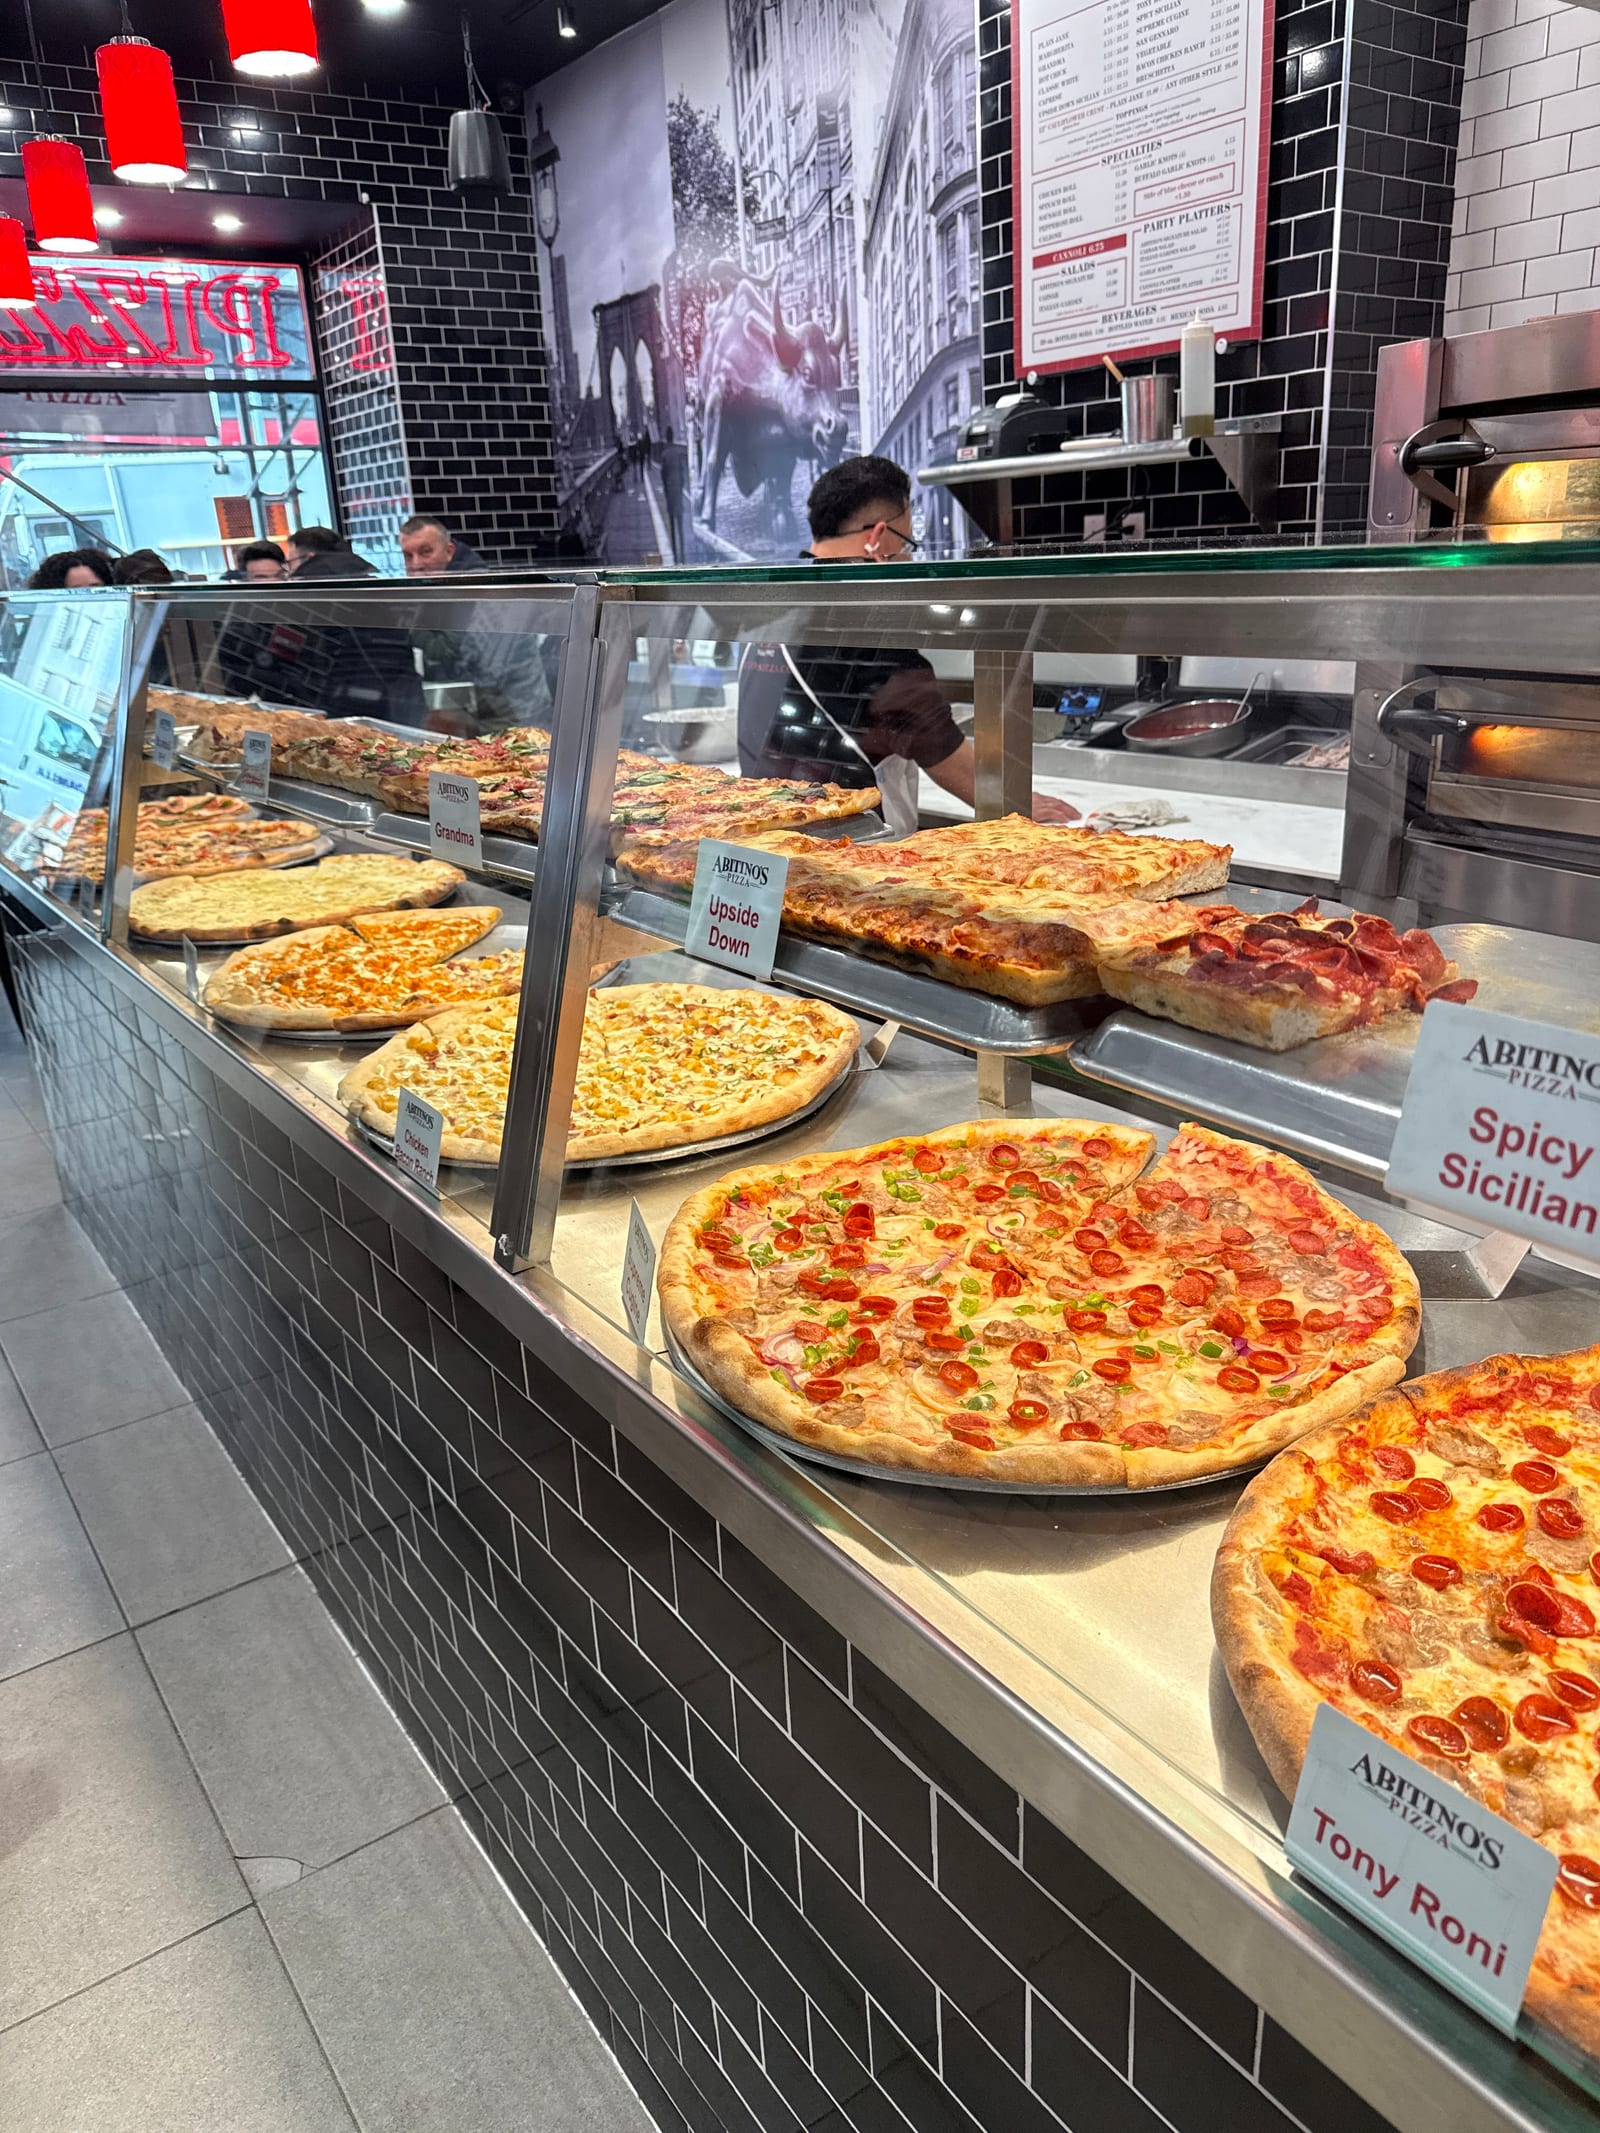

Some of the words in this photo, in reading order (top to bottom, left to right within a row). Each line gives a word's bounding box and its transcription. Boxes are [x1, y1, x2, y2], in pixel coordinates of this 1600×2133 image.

[1136, 9, 1153, 23] SPICY
[1154, 0, 1181, 16] SICILIAN
[1136, 17, 1165, 35] SUPREME
[1165, 7, 1190, 24] CUGINE
[1038, 37, 1055, 50] PLAIN
[1055, 31, 1069, 43] JANE
[1135, 36, 1148, 47] SAN
[1148, 24, 1179, 42] GENNARO
[1038, 40, 1074, 61] MARGHERITA
[1135, 39, 1172, 60] VEGETABLE
[1135, 58, 1155, 72] BACON
[1156, 48, 1182, 64] CHICKEN
[1183, 39, 1205, 55] RANCH
[1038, 56, 1065, 73] GRANDMA
[1135, 63, 1175, 84] BRUSCHETTA
[1038, 81, 1058, 95] CLASSIC
[1060, 74, 1078, 87] WHITE
[1047, 110, 1086, 130] CAULIFLOWER
[1086, 104, 1104, 117] CRUST
[1109, 96, 1127, 109] PLAIN
[1128, 91, 1143, 103] JANE
[1165, 79, 1177, 90] ANY
[1178, 71, 1200, 85] OTHER
[1201, 64, 1221, 78] STYLE
[1075, 90, 1099, 105] SICILIAN
[1115, 103, 1148, 120] TOPPINGS
[1101, 138, 1162, 167] SPECIALTIES
[1134, 158, 1156, 171] GARLIC
[1157, 152, 1177, 164] KNOTS
[1134, 169, 1161, 183] BUFFALO
[1161, 162, 1185, 175] GARLIC
[1185, 156, 1206, 168] KNOTS
[1177, 178, 1196, 190] cheese
[1205, 171, 1224, 182] ranch
[1038, 187, 1061, 200] CHICKEN
[1062, 182, 1076, 193] ROLL
[1038, 198, 1061, 211] SPINACH
[1061, 194, 1075, 204] ROLL
[1062, 205, 1076, 215] ROLL
[1143, 216, 1174, 233] PARTY
[1178, 201, 1230, 225] PLATTERS
[1038, 218, 1067, 233] PEPPERONI
[1052, 245, 1087, 262] CANNOLI
[1060, 260, 1095, 277] SALADS
[1101, 304, 1156, 324] BEVERAGES
[1054, 332, 1077, 343] BOTTLED
[1107, 321, 1132, 332] BOTTLED
[1133, 317, 1153, 327] WATER
[1170, 309, 1196, 320] MEXICAN
[435, 822, 475, 847] Grandma
[712, 855, 769, 886] ABITINO'S
[726, 873, 750, 887] PIZZA
[709, 894, 760, 929] Upside
[708, 925, 750, 958] Down
[1508, 1068, 1577, 1101] PIZZA
[404, 1128, 429, 1159] Chicken
[1468, 1106, 1595, 1179] Spicy
[394, 1143, 414, 1168] Bacon
[414, 1158, 434, 1184] Ranch
[1438, 1152, 1599, 1234] Sicilian
[1350, 1753, 1504, 1870] ABITINO'S
[1387, 1798, 1449, 1849] PIZZA
[1313, 1807, 1400, 1899] Tony
[1409, 1882, 1508, 1977] Roni
